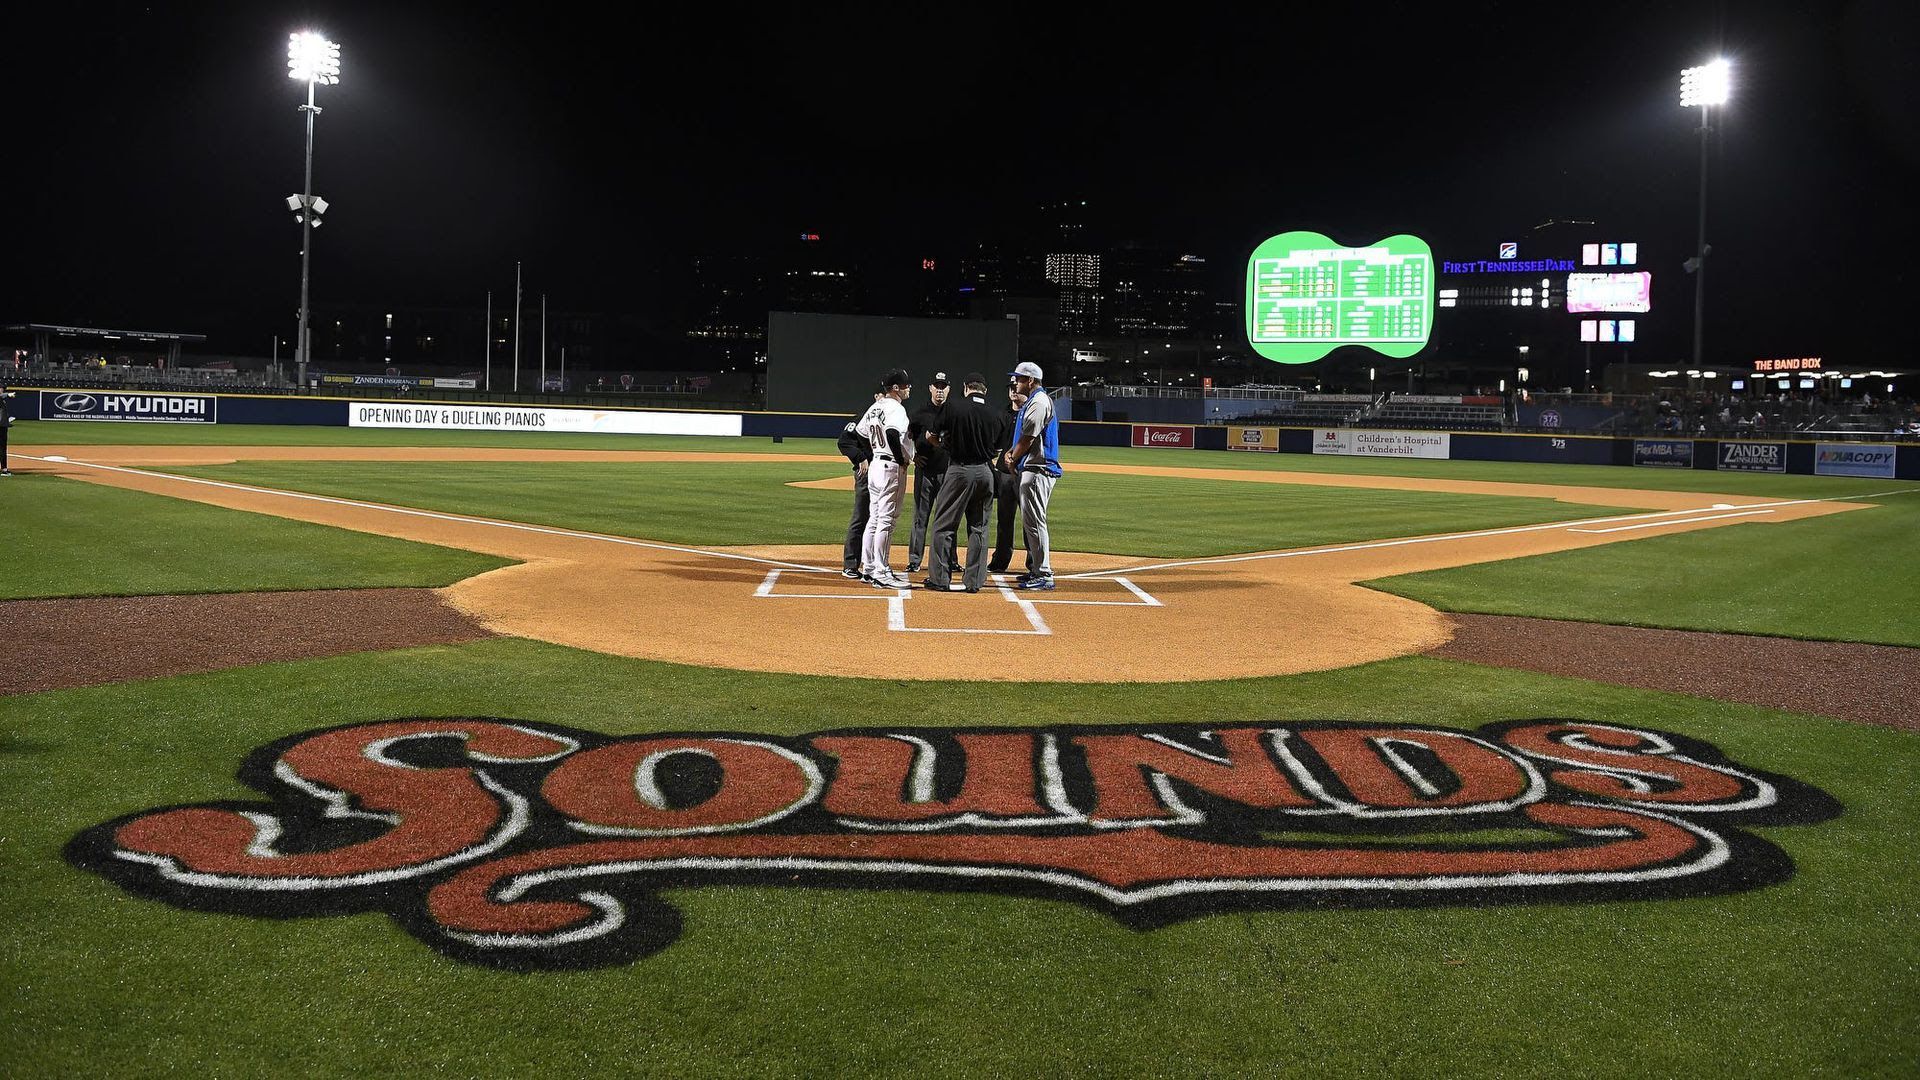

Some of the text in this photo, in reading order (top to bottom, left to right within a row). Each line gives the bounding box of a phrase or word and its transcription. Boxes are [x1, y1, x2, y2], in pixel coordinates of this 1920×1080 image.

[1443, 259, 1575, 273] FIRST TENNESSEE PARK
[1754, 358, 1821, 370] THE BAND BOX
[354, 376, 384, 384] ZANDER
[104, 396, 205, 414] HYUNDAI
[360, 407, 411, 423] OPENING
[415, 409, 438, 424] DAY
[441, 411, 449, 424] &
[452, 410, 501, 425] DUELING
[505, 412, 545, 427] PIANOS
[1542, 415, 1558, 423] 375
[844, 422, 856, 432] 18
[870, 424, 886, 449] 20
[1357, 434, 1442, 446] Children's Hospital
[1367, 445, 1414, 454] Vanderbilt
[1724, 444, 1778, 462] ZANDER
[1734, 456, 1778, 465] INSURANCE
[1819, 450, 1893, 464] NOVACOPY
[108, 718, 1788, 950] SOUNDS
